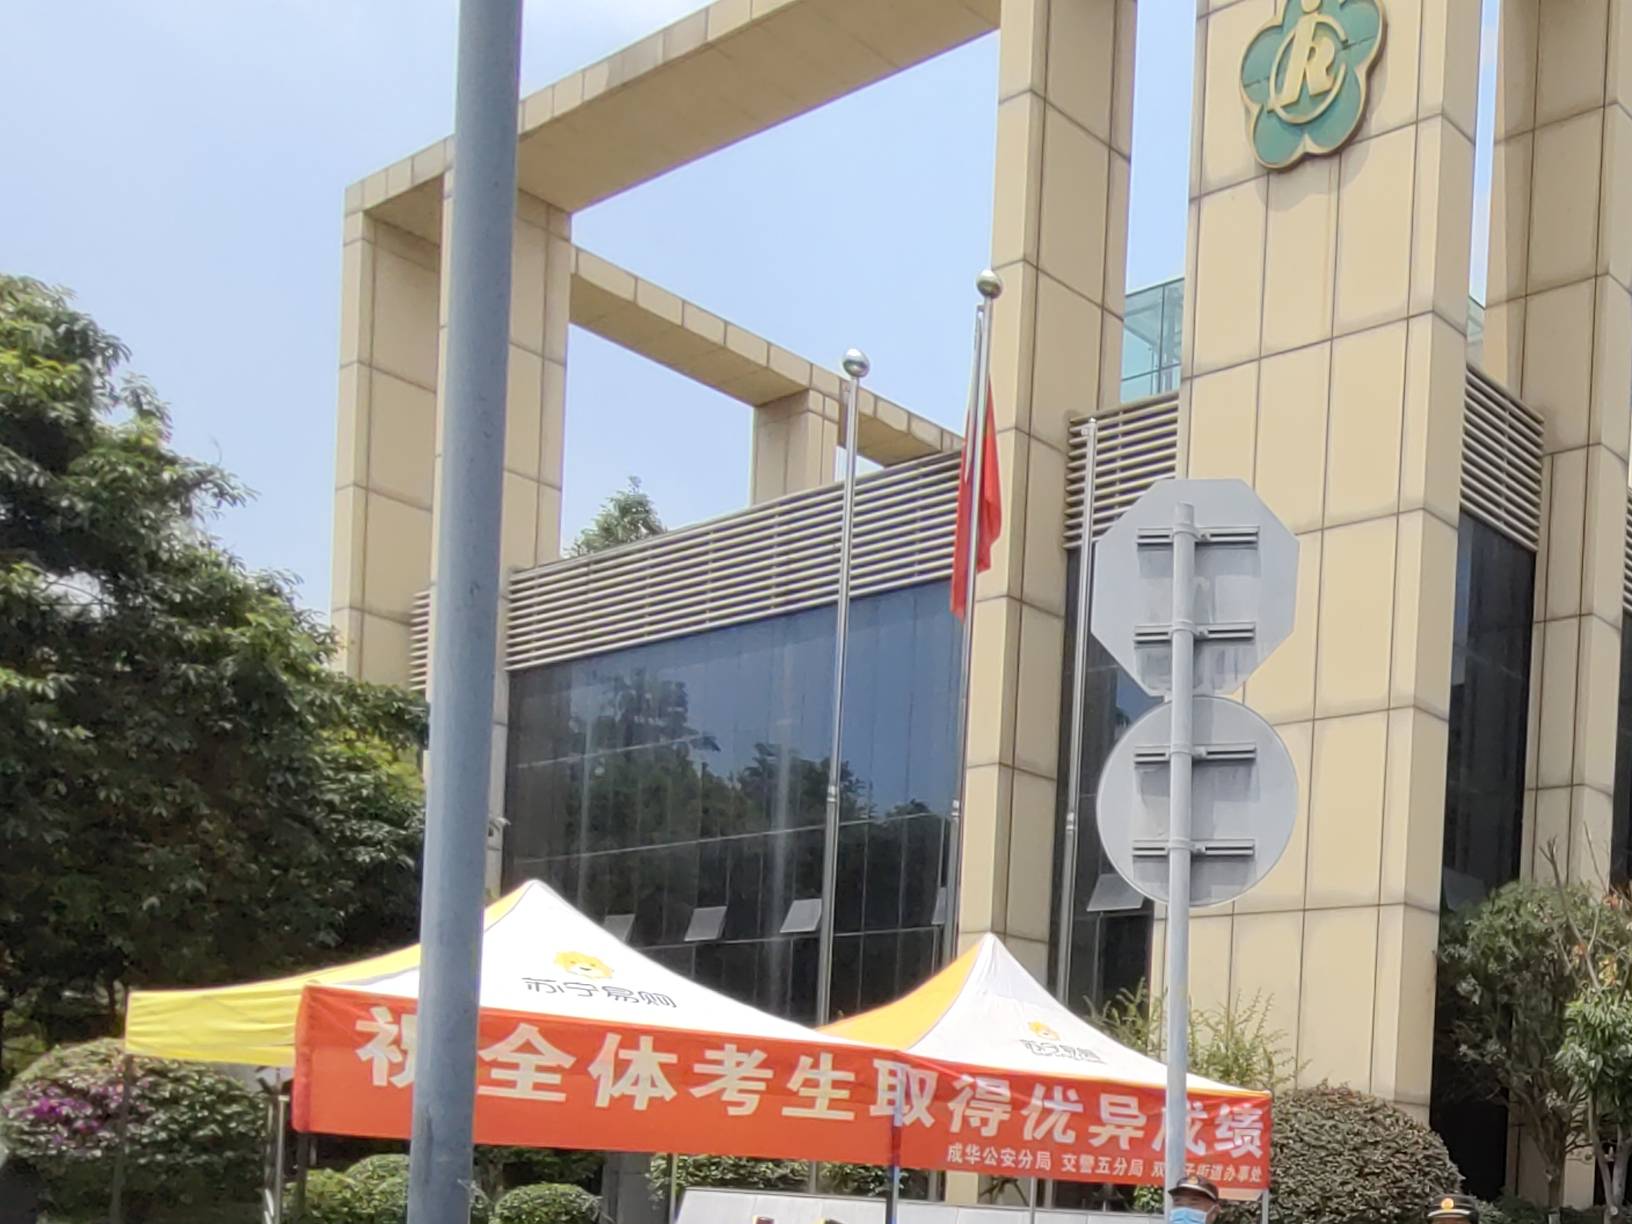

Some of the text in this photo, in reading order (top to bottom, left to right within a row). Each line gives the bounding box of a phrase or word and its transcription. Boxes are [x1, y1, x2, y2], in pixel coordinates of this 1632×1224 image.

[946, 1142, 1052, 1171] 成华公安分局
[1061, 1153, 1145, 1178] 交警五分局
